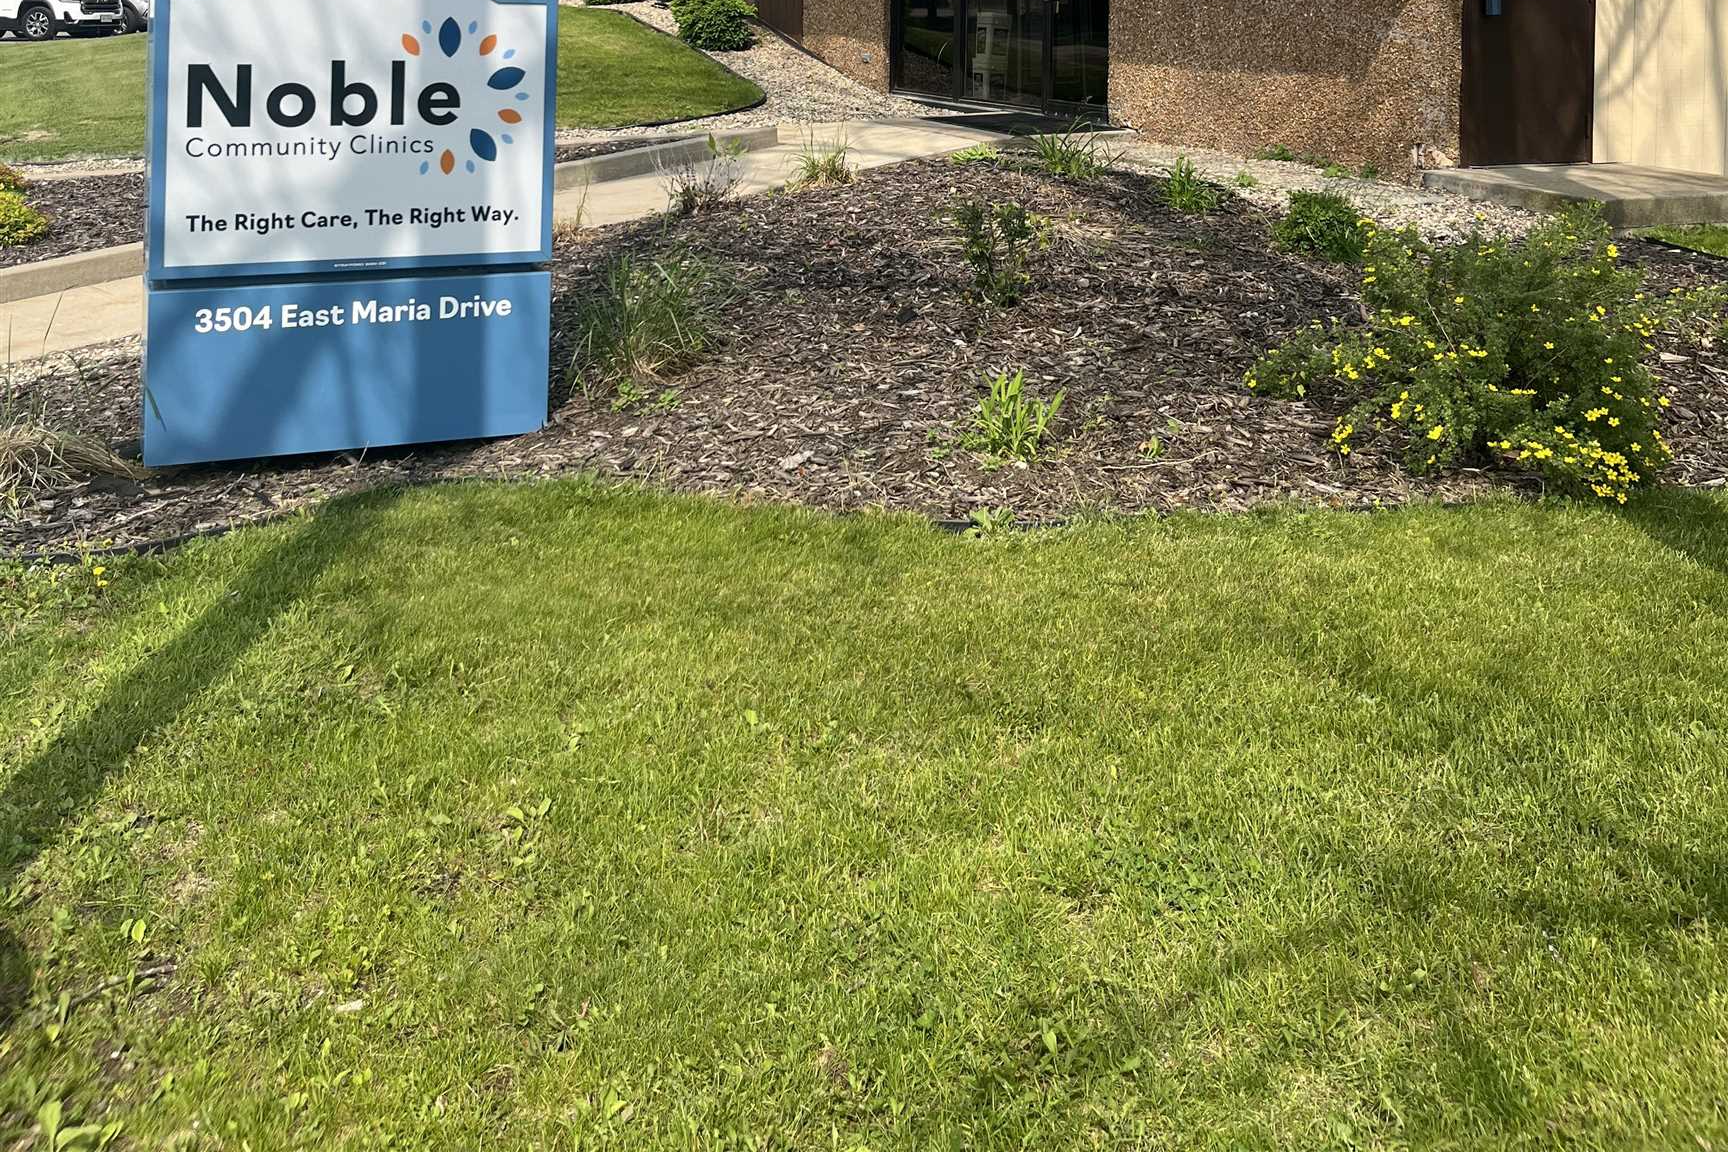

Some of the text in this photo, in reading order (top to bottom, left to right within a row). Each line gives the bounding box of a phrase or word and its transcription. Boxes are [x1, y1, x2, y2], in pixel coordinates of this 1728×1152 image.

[186, 60, 461, 128] Noble
[186, 134, 434, 160] Community Clinics
[186, 205, 519, 235] The Right Care, The Right Way.
[194, 295, 512, 333] 3504 East Maria Drive
